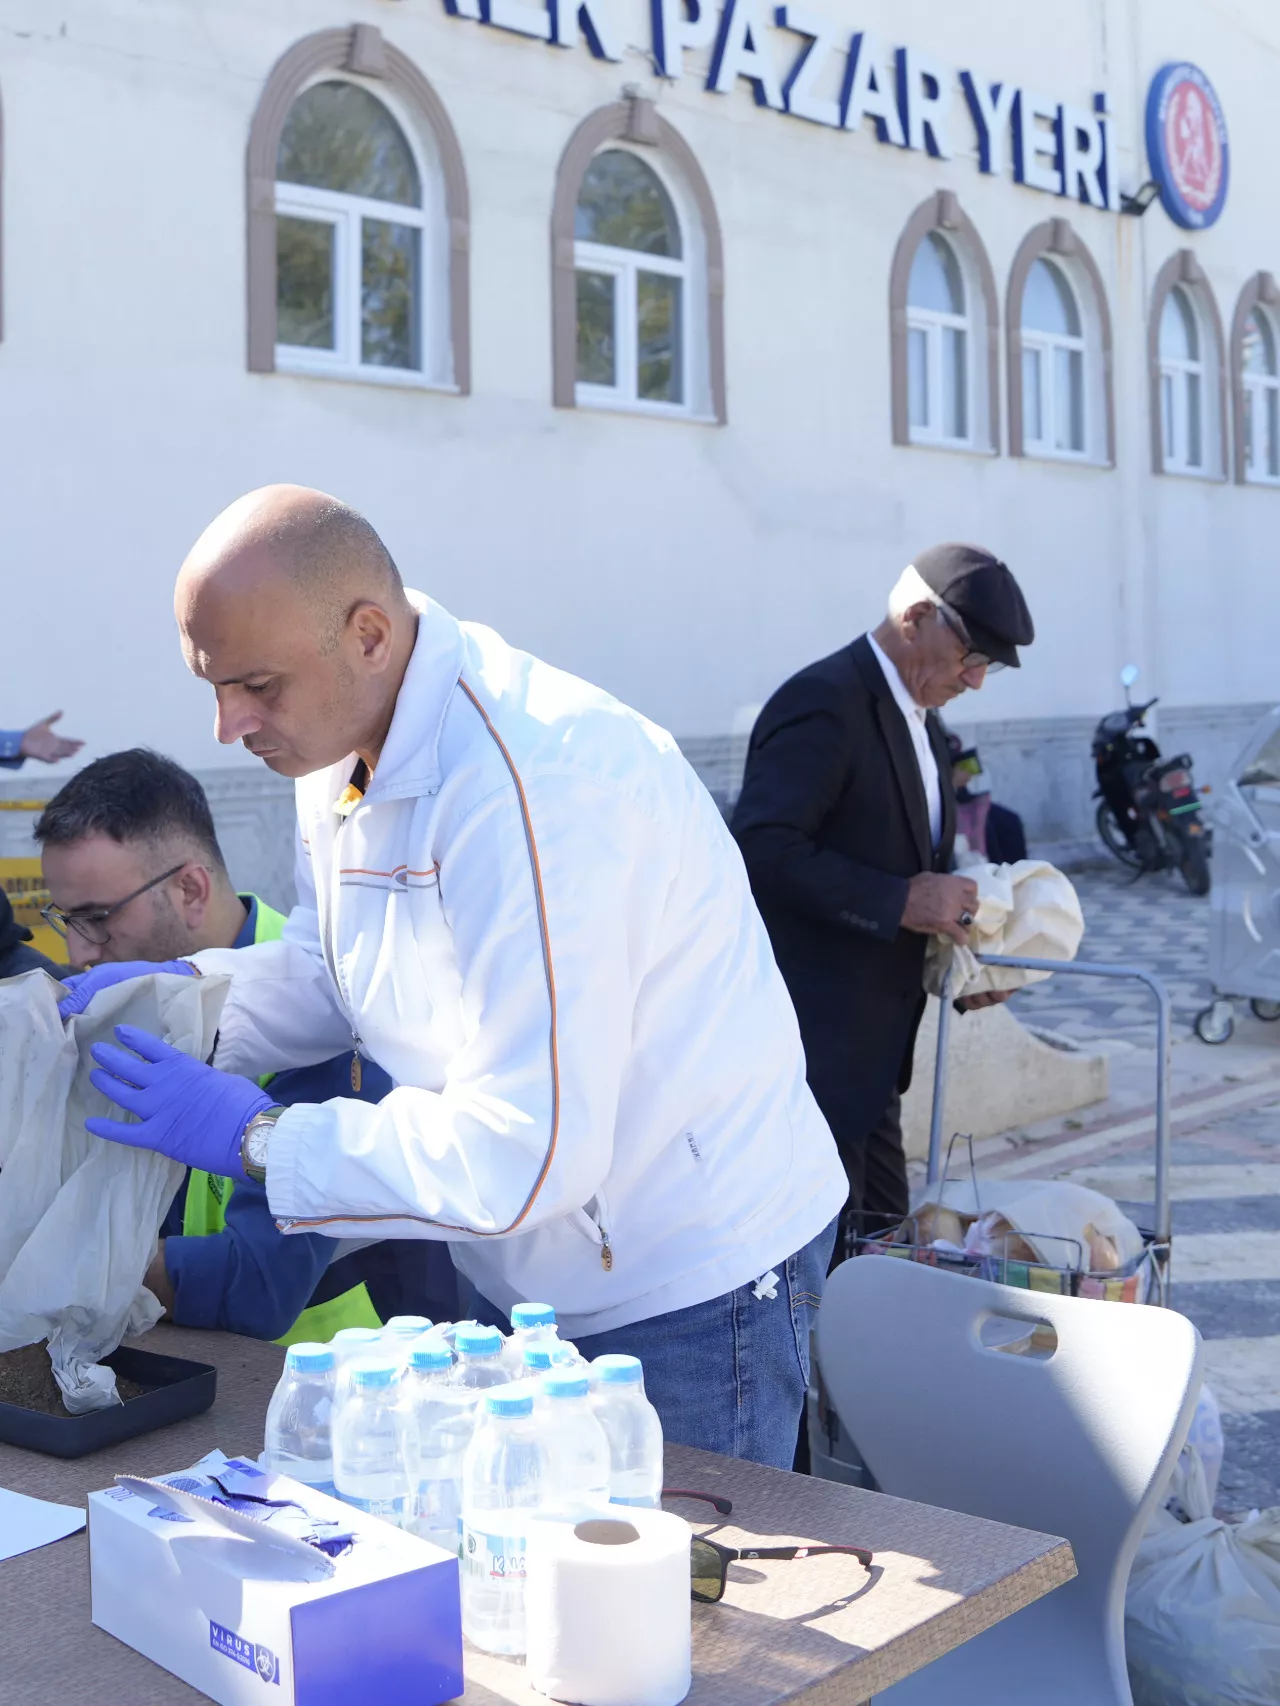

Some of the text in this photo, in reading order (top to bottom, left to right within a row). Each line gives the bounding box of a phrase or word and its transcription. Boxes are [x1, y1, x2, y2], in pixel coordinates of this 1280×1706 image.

[651, 0, 951, 161] PAZAR
[958, 68, 1120, 213] YERİ
[212, 1625, 250, 1656] VIRUS
